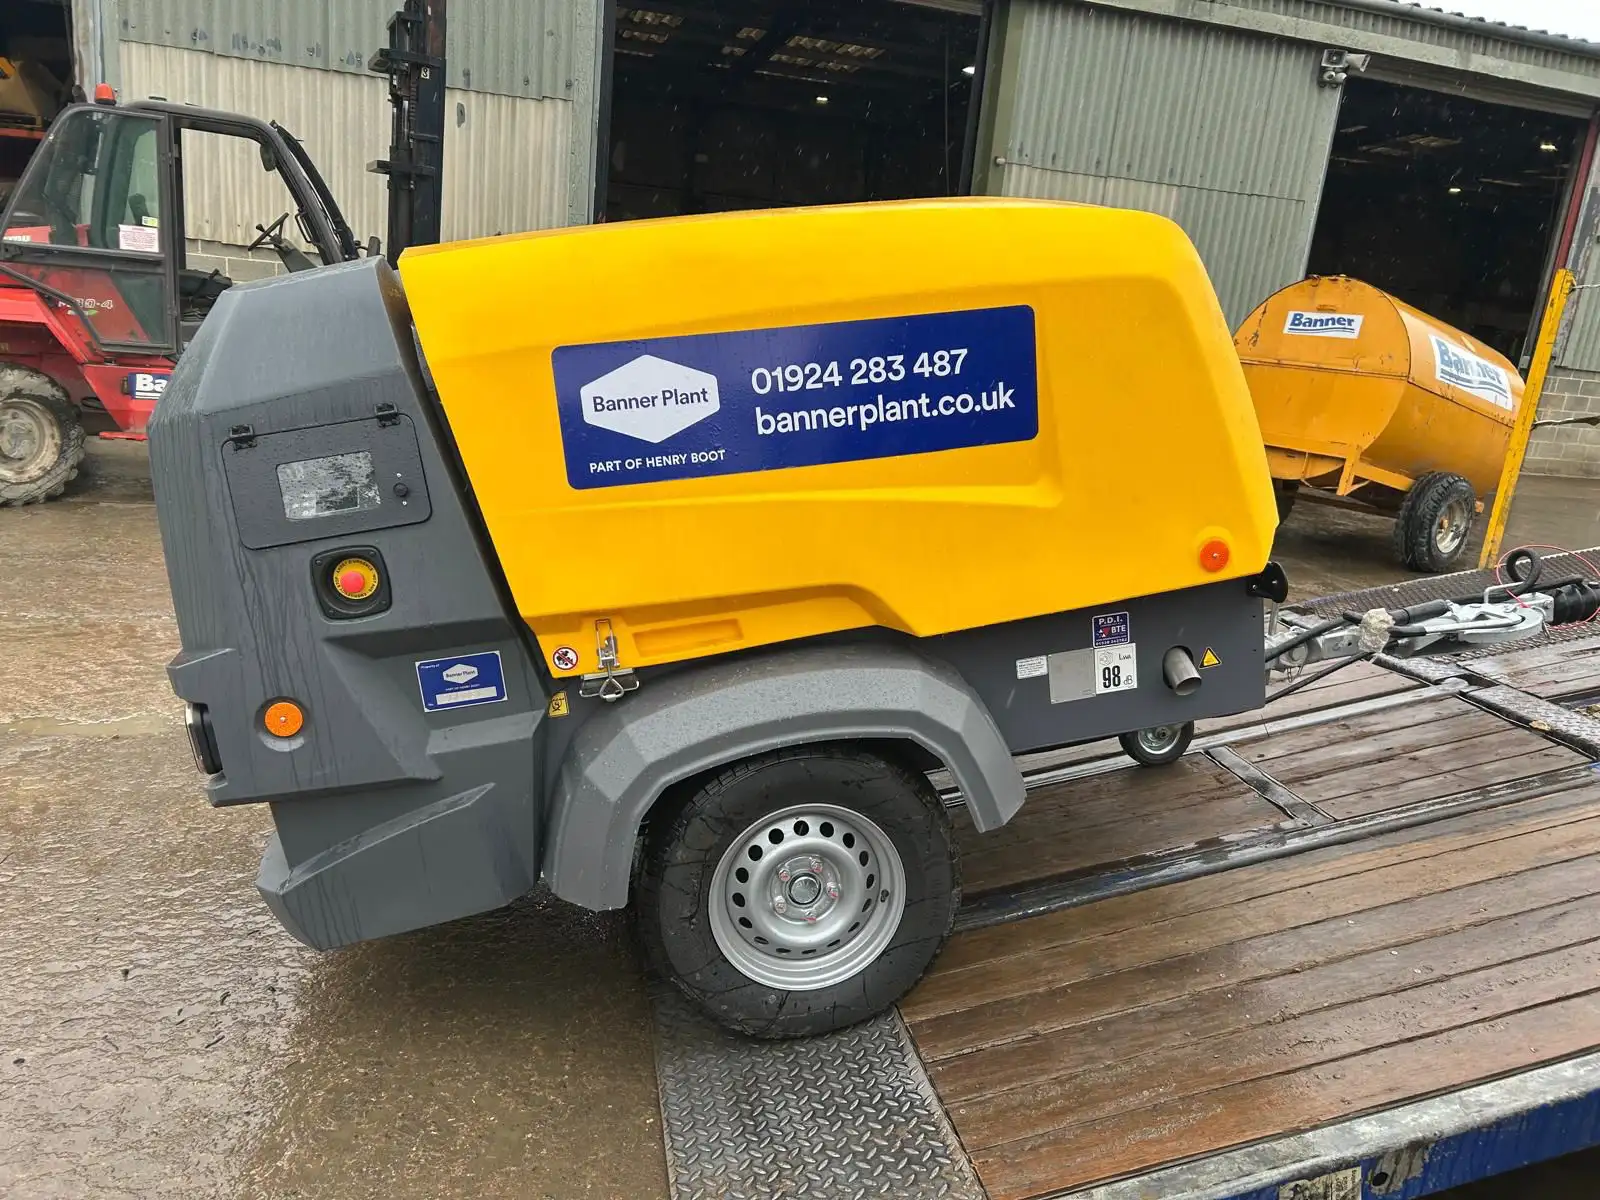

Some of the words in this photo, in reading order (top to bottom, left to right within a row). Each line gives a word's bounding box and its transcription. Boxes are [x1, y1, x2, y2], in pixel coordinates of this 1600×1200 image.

[1290, 313, 1355, 327] Banner
[751, 361, 843, 395] 01924
[850, 354, 905, 385] 283
[912, 348, 968, 378] 487
[592, 394, 659, 413] Banner
[661, 387, 709, 406] Plant
[755, 381, 1016, 435] bannerplant.co.uk
[589, 460, 622, 474] PART
[625, 458, 643, 470] OF
[646, 454, 688, 468] HENRY
[691, 449, 726, 463] BOOT
[1098, 615, 1123, 625] P.D.I.
[1111, 624, 1127, 634] BTE
[1102, 665, 1121, 688] 98
